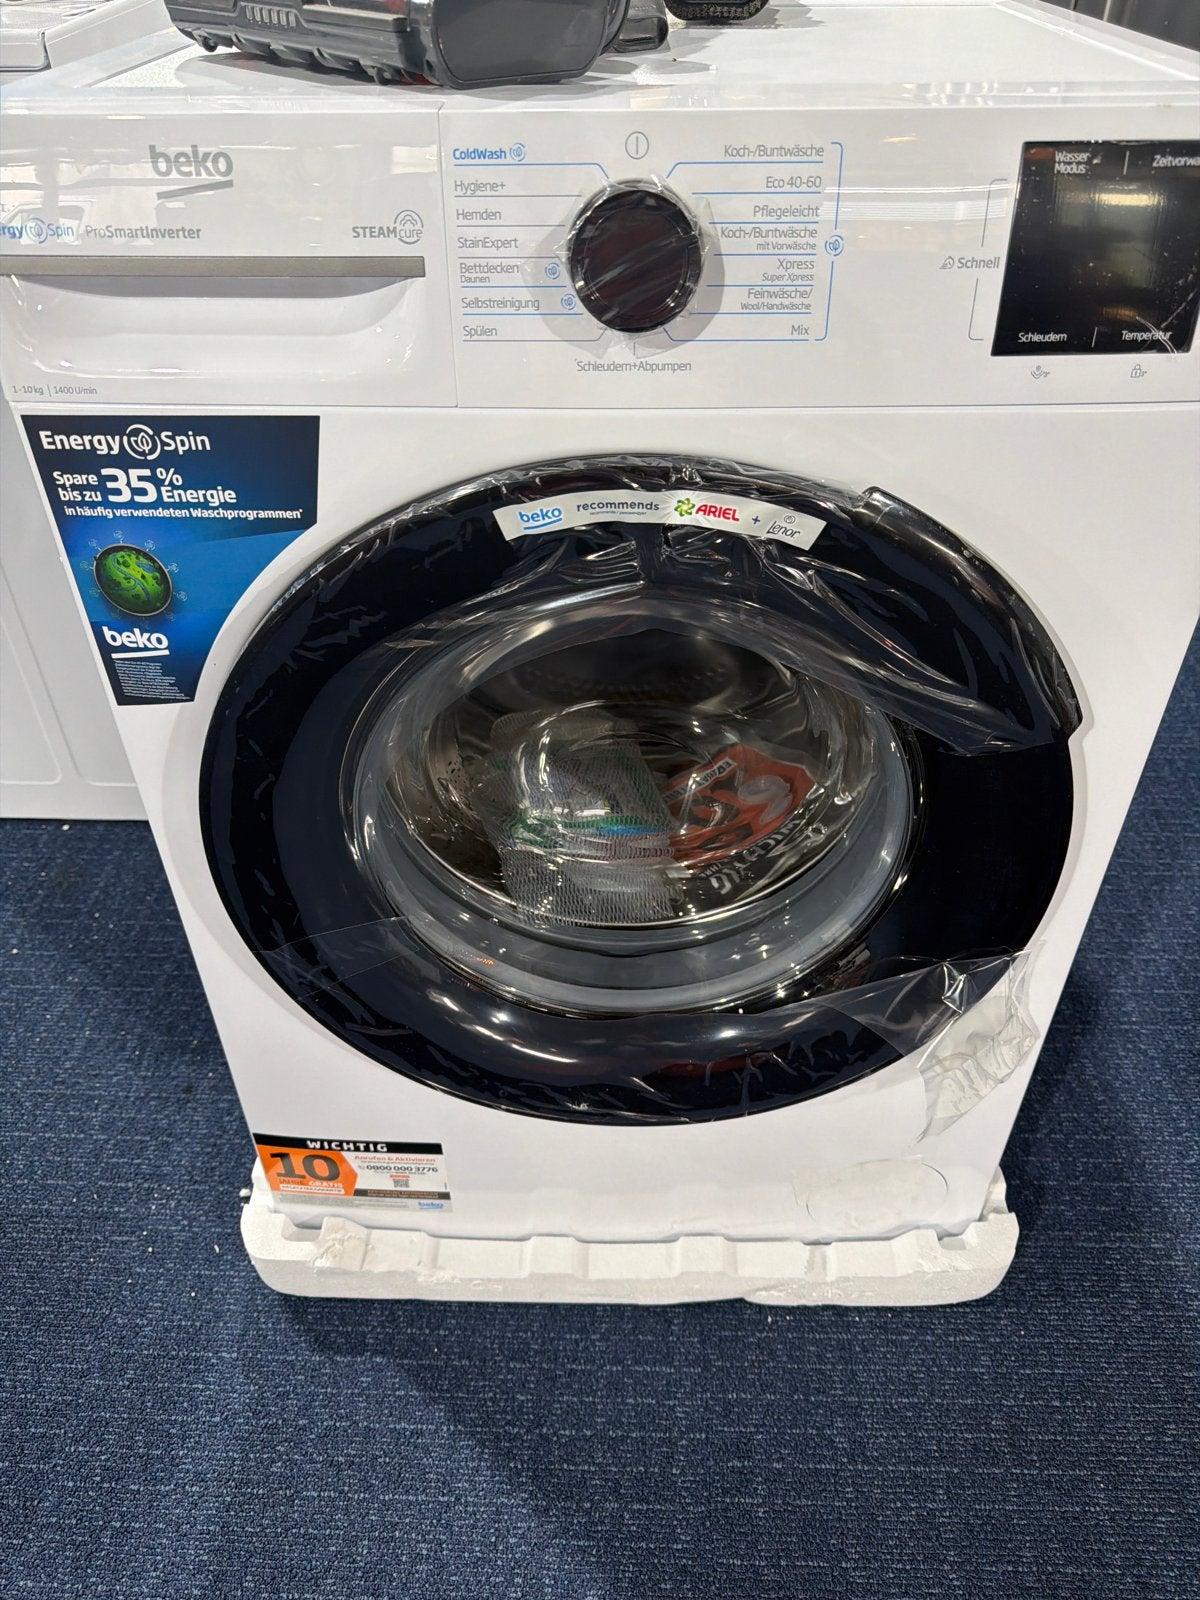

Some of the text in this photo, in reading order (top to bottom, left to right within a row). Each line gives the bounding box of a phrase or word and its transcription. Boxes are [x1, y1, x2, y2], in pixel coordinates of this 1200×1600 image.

[452, 147, 507, 160] ColdWash
[723, 144, 825, 158] Koch-/Buntwäsche
[1054, 151, 1091, 163] Wasser
[148, 144, 235, 178] beko
[1053, 162, 1087, 174] Modus
[453, 179, 506, 193] Hygiene+
[765, 175, 822, 188] Eco 40-60
[455, 207, 502, 221] Hemden
[752, 204, 820, 220] Pflegeleicht
[0, 223, 75, 240] rgy Spin
[85, 224, 202, 240] ProSmartInverter
[720, 226, 818, 239] Koch-/Buntwäsche
[457, 236, 519, 250] StainExpert
[756, 241, 817, 251] mit Vorwäsche
[459, 262, 520, 274] Bettdecken
[777, 258, 815, 271] Xpress
[957, 256, 1000, 269] Schnell
[460, 274, 491, 284] Daunen
[761, 272, 814, 283] Super Xpress
[747, 287, 813, 299] Feinwäsche/
[461, 297, 540, 311] Selbstreinigung
[740, 301, 812, 311] Wool/Handwäsche
[463, 325, 498, 338] Spülen
[790, 324, 810, 336] Mix
[1121, 330, 1173, 342] Temperatur
[1017, 332, 1067, 343] Schleudern
[576, 360, 692, 373] Schleudern+Abpumpen
[54, 385, 74, 396] 1400
[38, 430, 211, 456] Energy Spin
[52, 471, 98, 488] Spare
[101, 467, 183, 503] 35 %
[57, 487, 102, 502] bis zu
[160, 486, 237, 506] Energie
[64, 506, 76, 517] in
[76, 506, 113, 519] häufig
[113, 508, 190, 518] verwendeten
[576, 501, 660, 512] recommends
[695, 504, 740, 522] ARIEL
[518, 507, 563, 523] beko
[765, 520, 801, 539] Lenor
[101, 626, 169, 649] beko
[305, 1140, 388, 1152] WICHTIG
[269, 1152, 341, 1181] 10
[366, 1164, 439, 1173] 0800 000 3776
